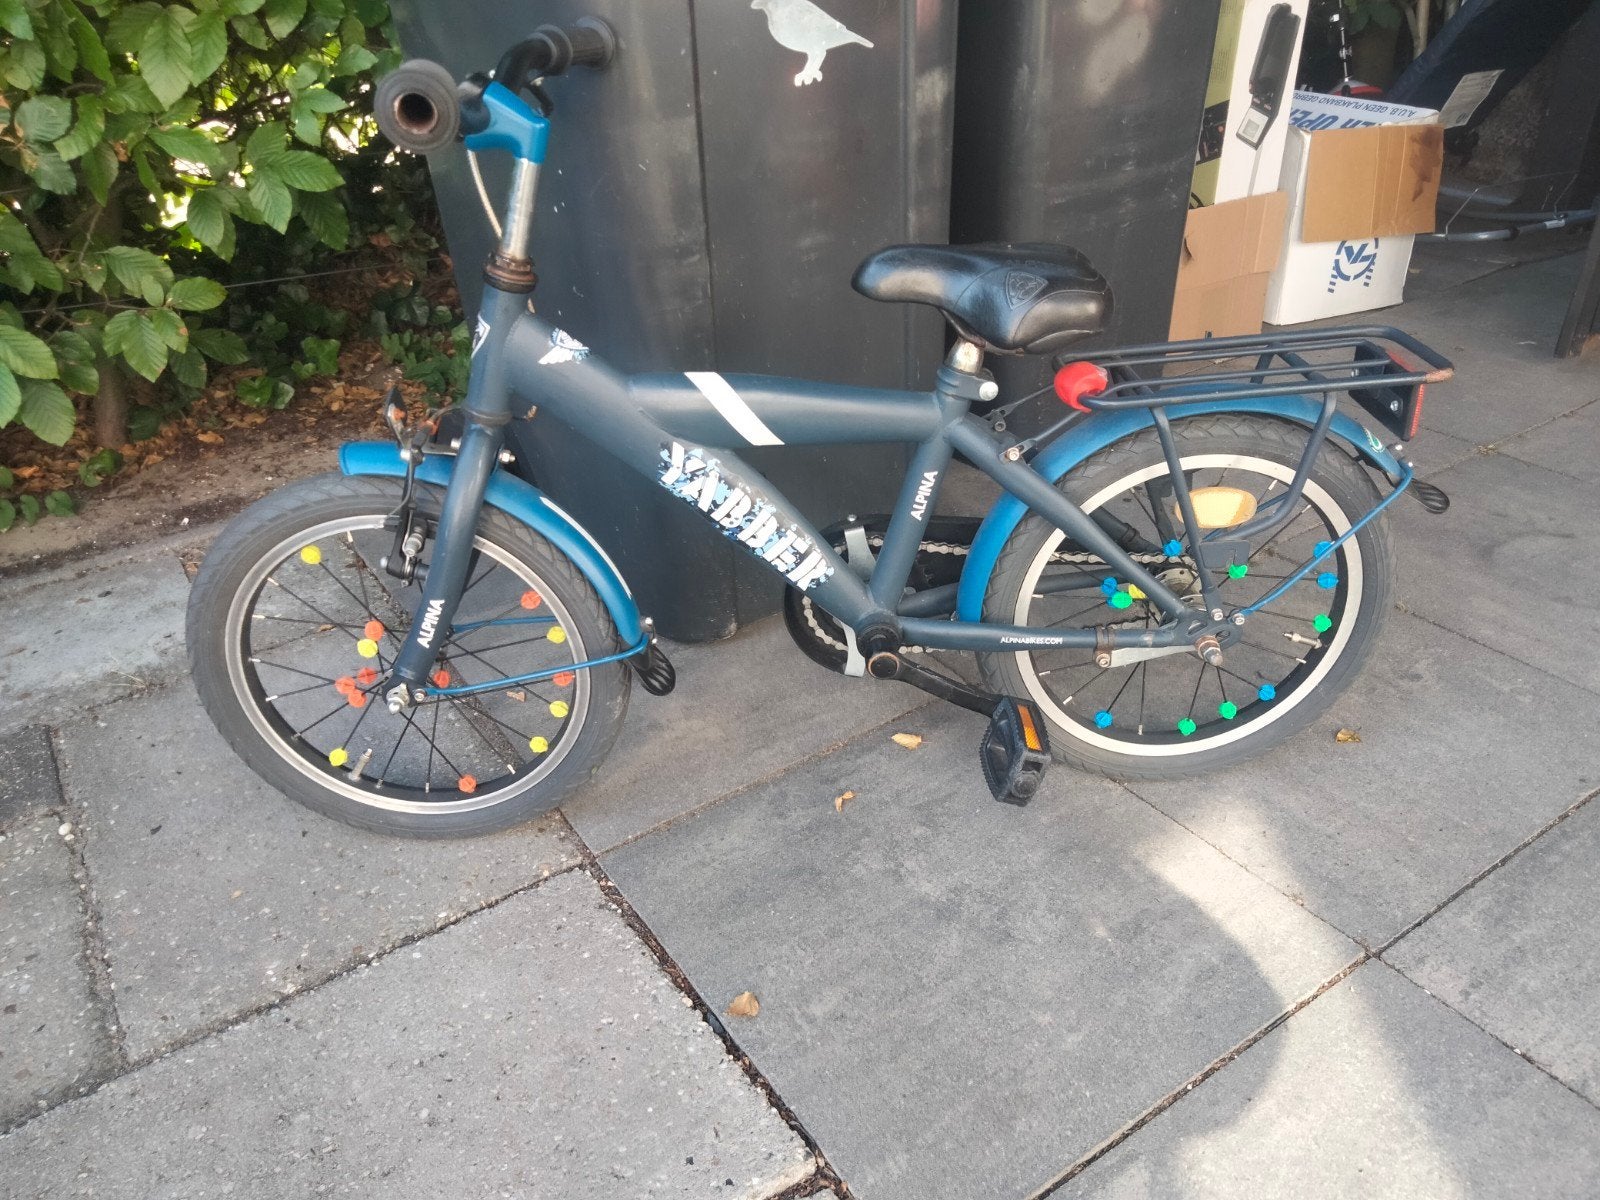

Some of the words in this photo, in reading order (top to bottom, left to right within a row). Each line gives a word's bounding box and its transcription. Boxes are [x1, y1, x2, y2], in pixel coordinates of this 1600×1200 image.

[1319, 97, 1364, 109] PLAKBAND
[1364, 103, 1388, 113] GEEN
[911, 471, 938, 521] ALPINA
[660, 440, 828, 592] YABBER
[416, 599, 445, 649] ALPINA
[1000, 636, 1063, 645] ALPINABIKES.COM
